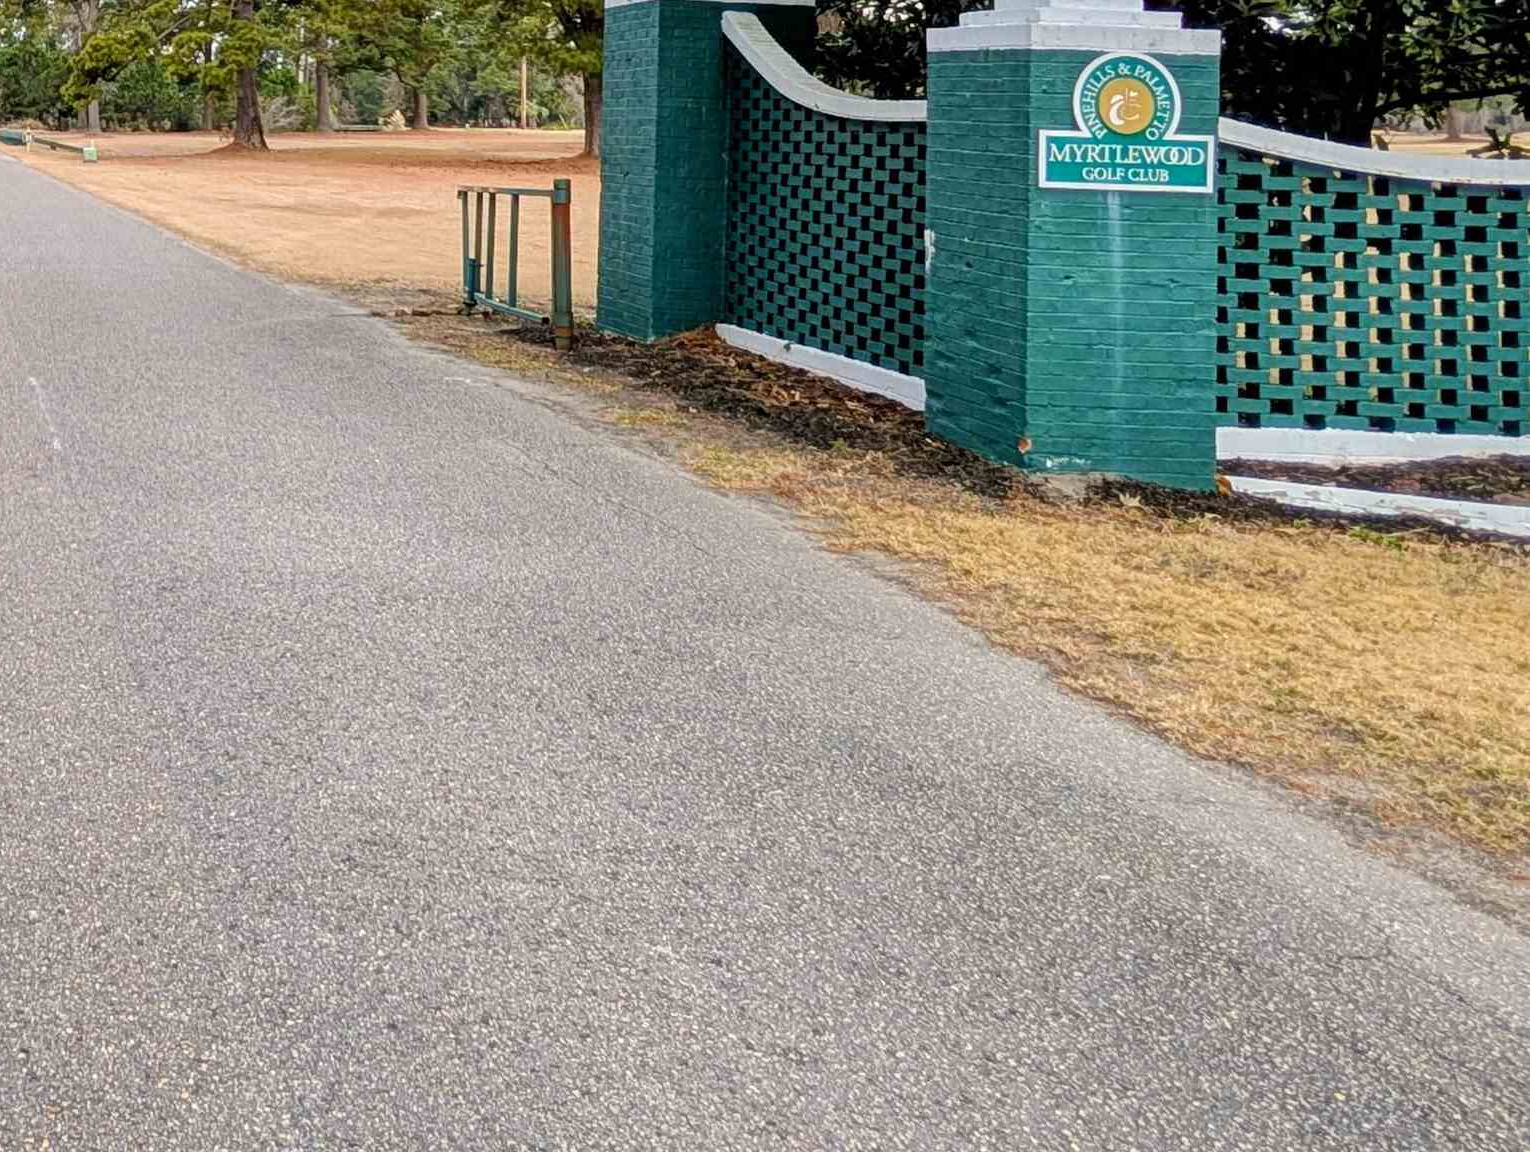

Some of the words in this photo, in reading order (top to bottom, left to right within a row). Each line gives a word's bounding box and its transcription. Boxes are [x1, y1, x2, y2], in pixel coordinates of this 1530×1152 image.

[1117, 63, 1131, 76] &
[1048, 143, 1205, 166] MYRTLEWOOD
[1082, 167, 1125, 180] GOLF
[1128, 168, 1169, 182] CLUB
